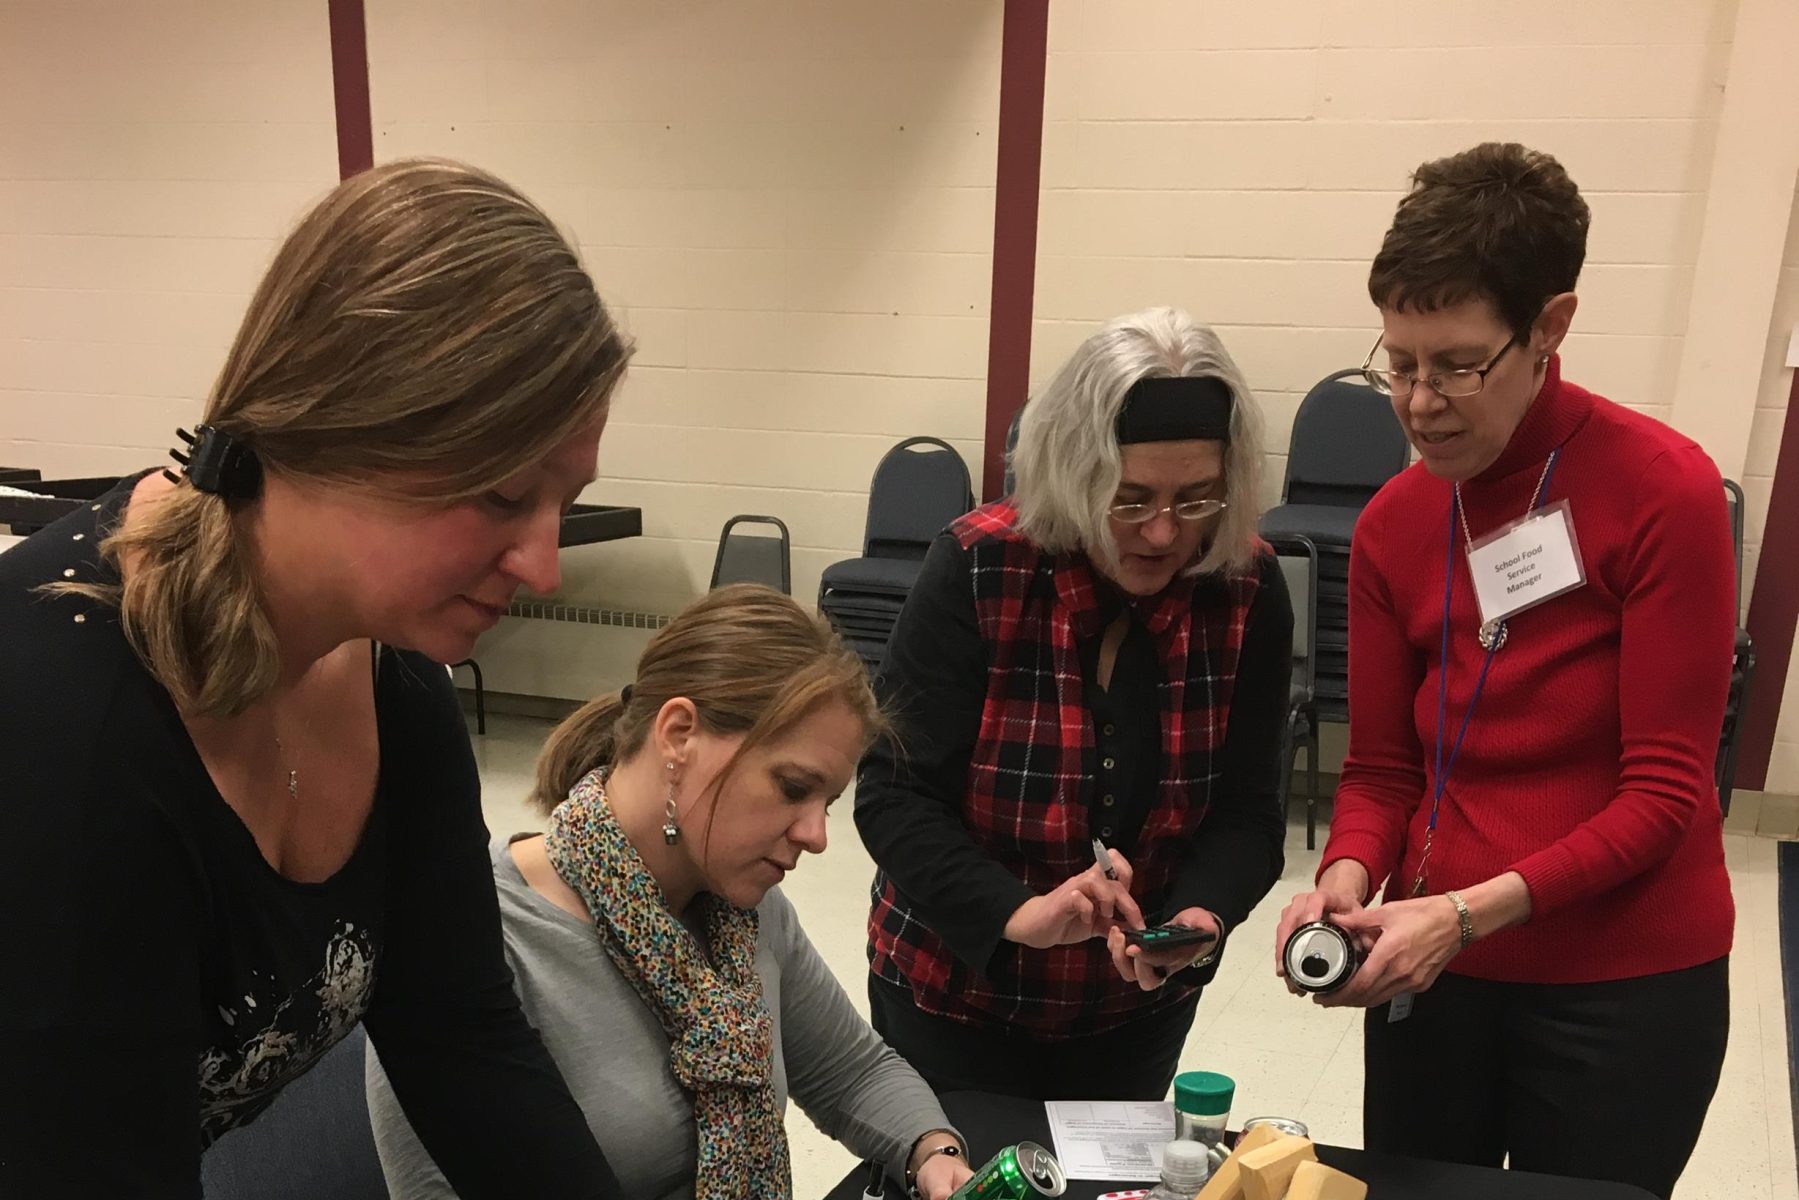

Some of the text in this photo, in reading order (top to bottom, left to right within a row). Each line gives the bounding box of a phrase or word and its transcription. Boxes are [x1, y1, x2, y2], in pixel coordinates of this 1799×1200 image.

[1494, 544, 1543, 573] School Food
[1507, 563, 1536, 581] Service
[1506, 573, 1542, 594] Manager
